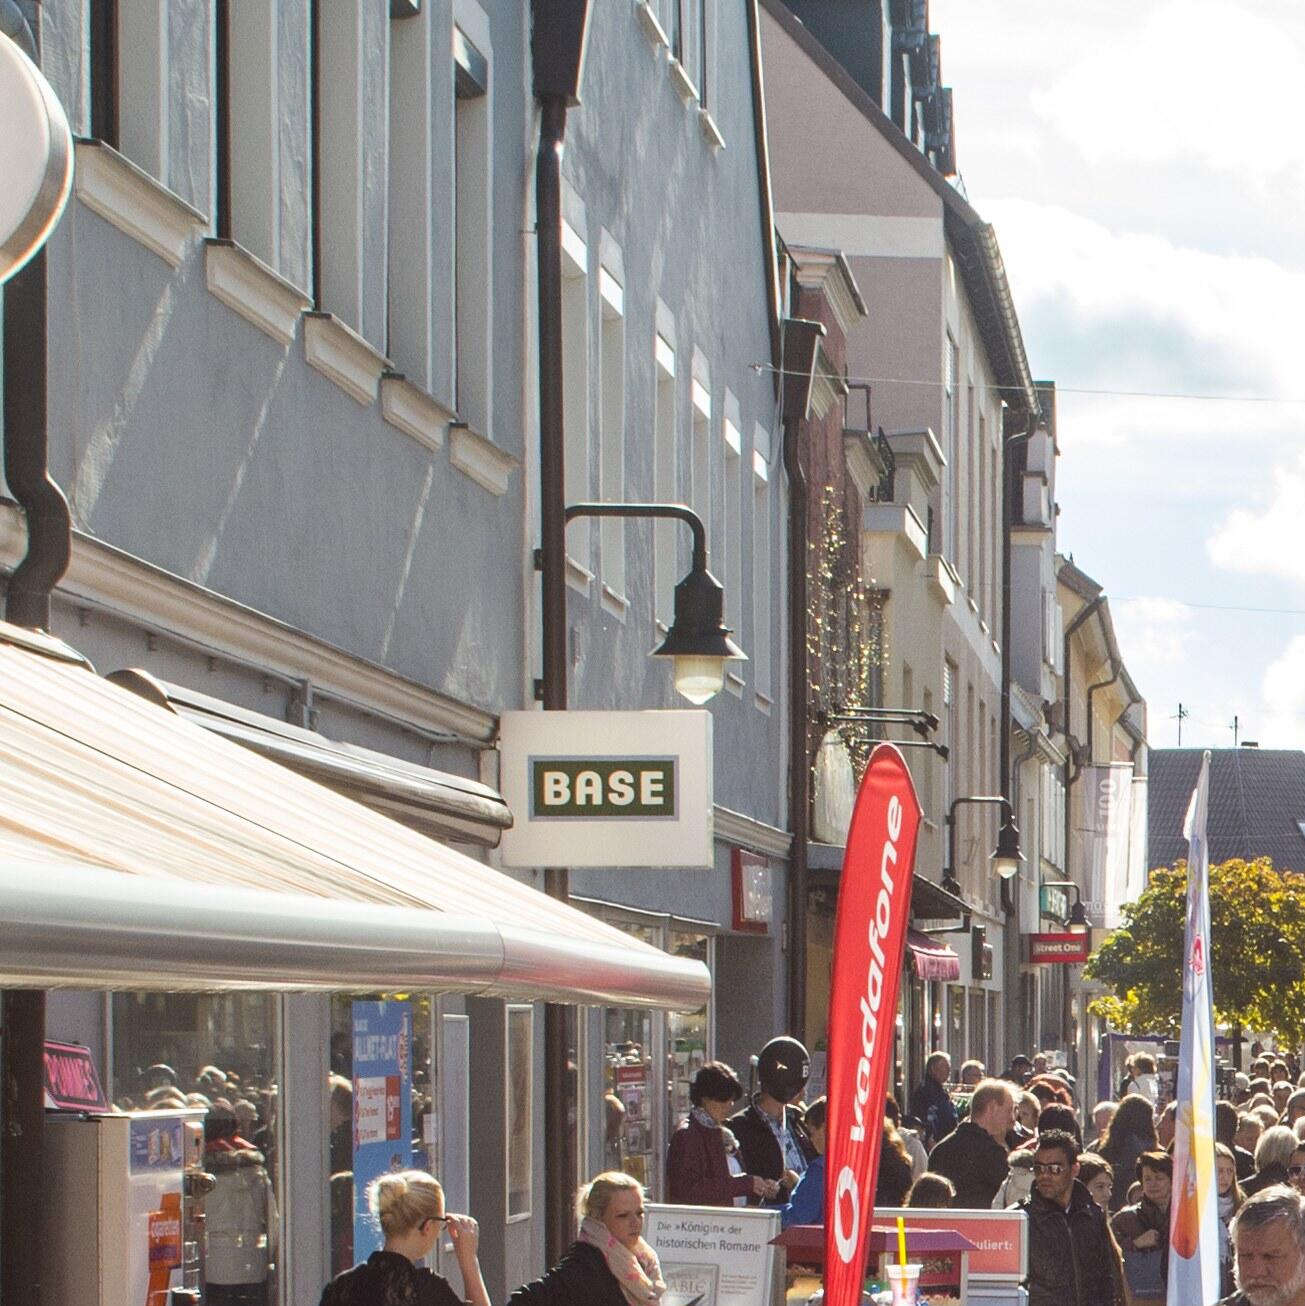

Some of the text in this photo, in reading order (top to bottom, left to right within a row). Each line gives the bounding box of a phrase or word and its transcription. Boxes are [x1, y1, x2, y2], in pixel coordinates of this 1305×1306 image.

[543, 770, 664, 806] BASE
[1064, 942, 1081, 953] One
[850, 795, 903, 1145] vodafone
[657, 1221, 672, 1231] Die
[727, 1225, 742, 1234] der
[656, 1238, 761, 1253] historischen Romane
[972, 1240, 1013, 1250] uliert:
